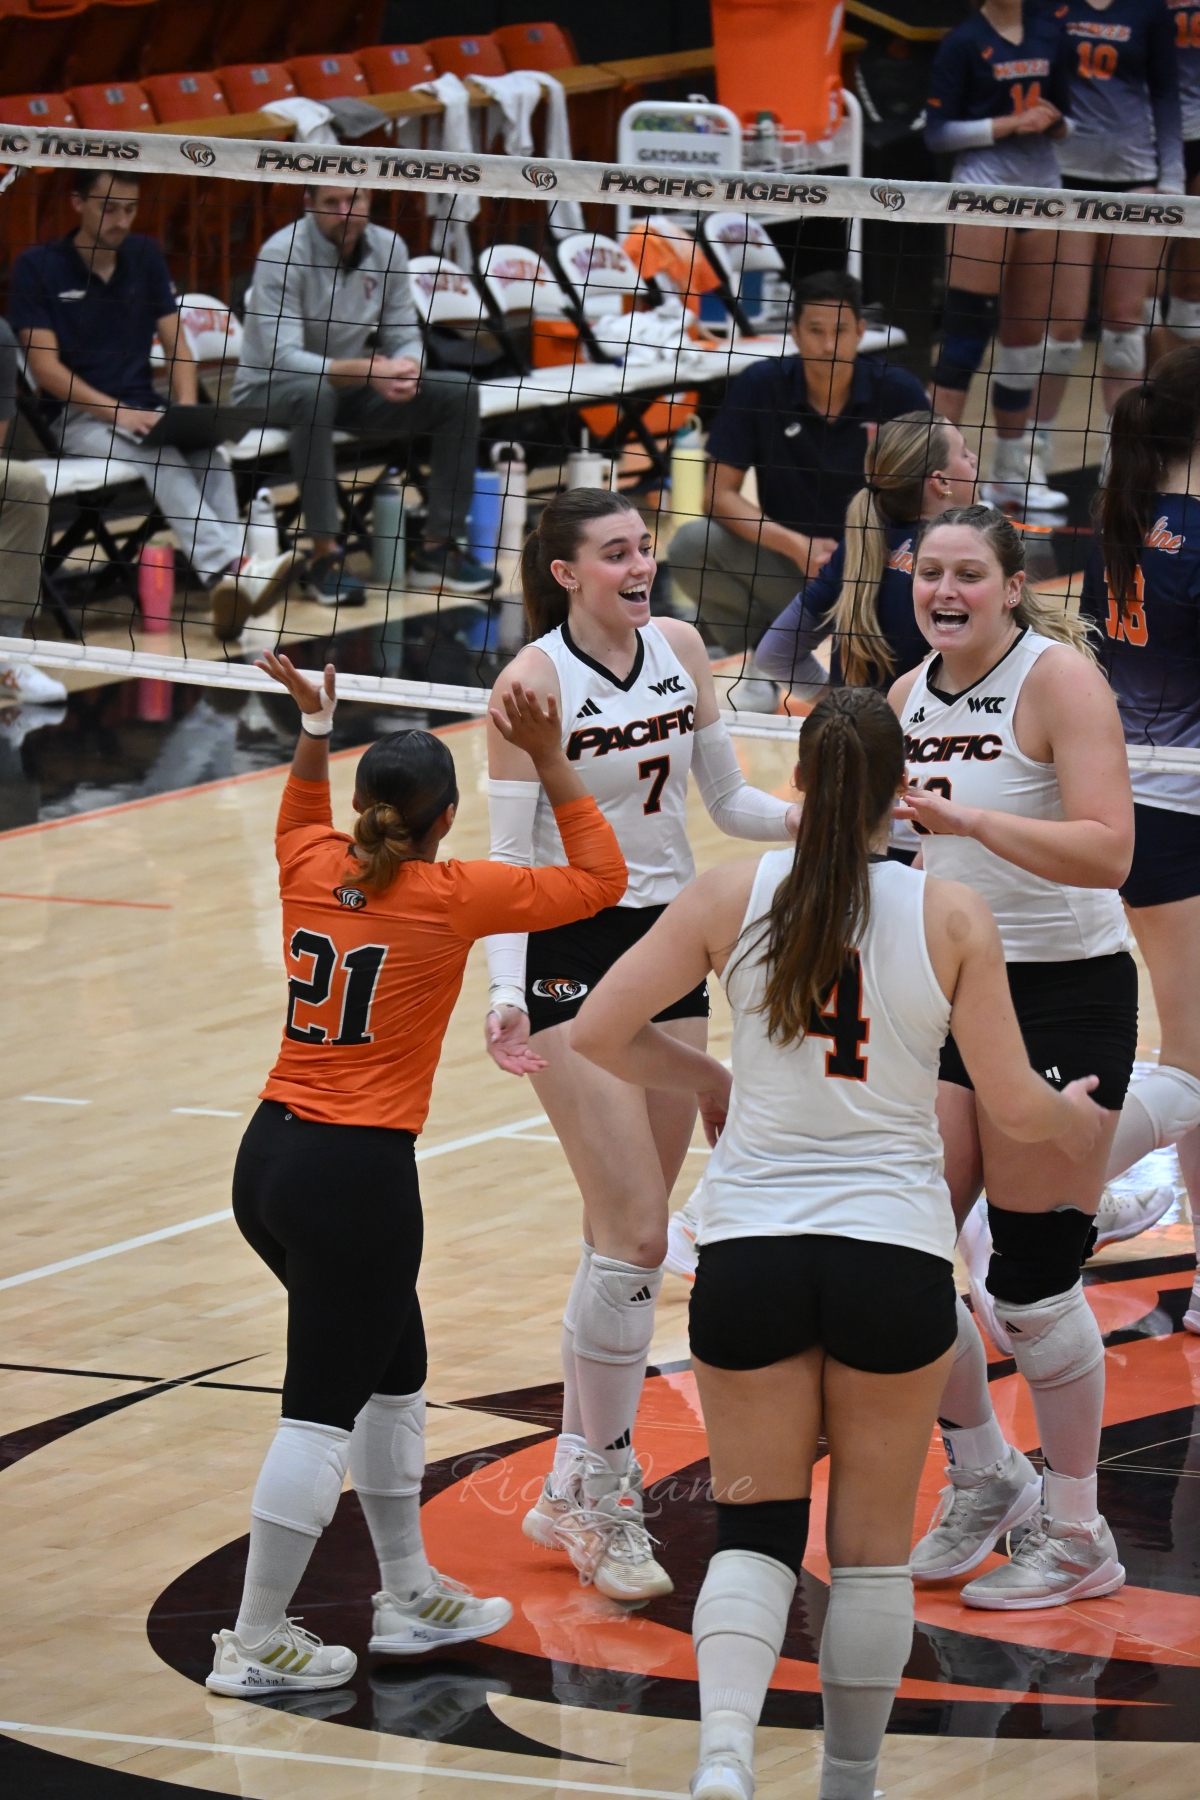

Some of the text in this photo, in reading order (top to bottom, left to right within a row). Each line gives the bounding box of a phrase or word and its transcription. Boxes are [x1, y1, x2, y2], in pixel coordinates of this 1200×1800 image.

[1077, 41, 1118, 80] 10
[36, 133, 141, 160] TIGERS
[255, 148, 482, 184] PACIFIC TIGERS
[598, 168, 830, 205] PACIFIC TIGERS
[946, 189, 1187, 226] PACIFIC TIGERS
[647, 675, 687, 697] WCC
[966, 696, 1007, 714] WCC
[565, 704, 695, 762] PACIFIC
[637, 754, 671, 816] 7
[286, 926, 390, 1046] 21
[803, 946, 871, 1083] 4
